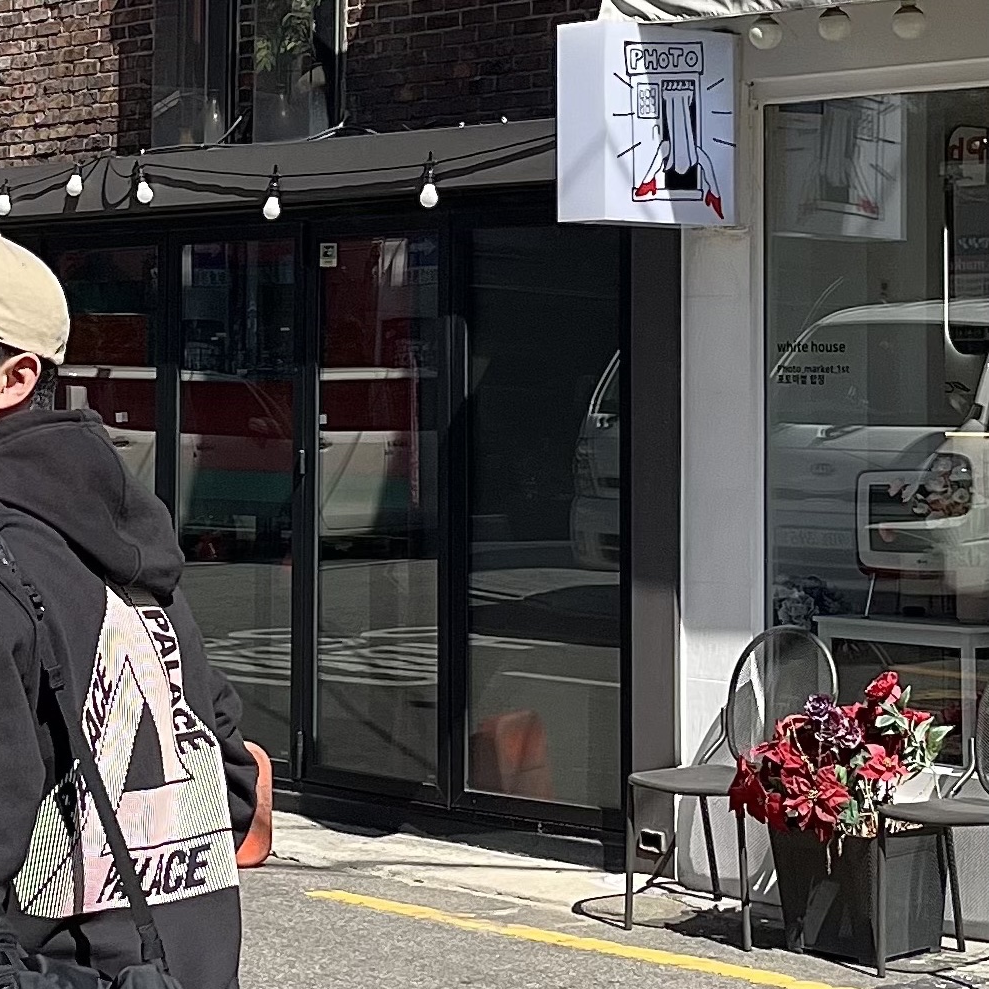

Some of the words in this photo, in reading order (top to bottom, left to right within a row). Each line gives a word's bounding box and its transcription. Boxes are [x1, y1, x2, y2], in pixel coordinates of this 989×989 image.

[630, 47, 698, 70] PHOTO
[777, 340, 808, 352] white
[811, 340, 845, 352] house
[142, 609, 216, 755] PALACE
